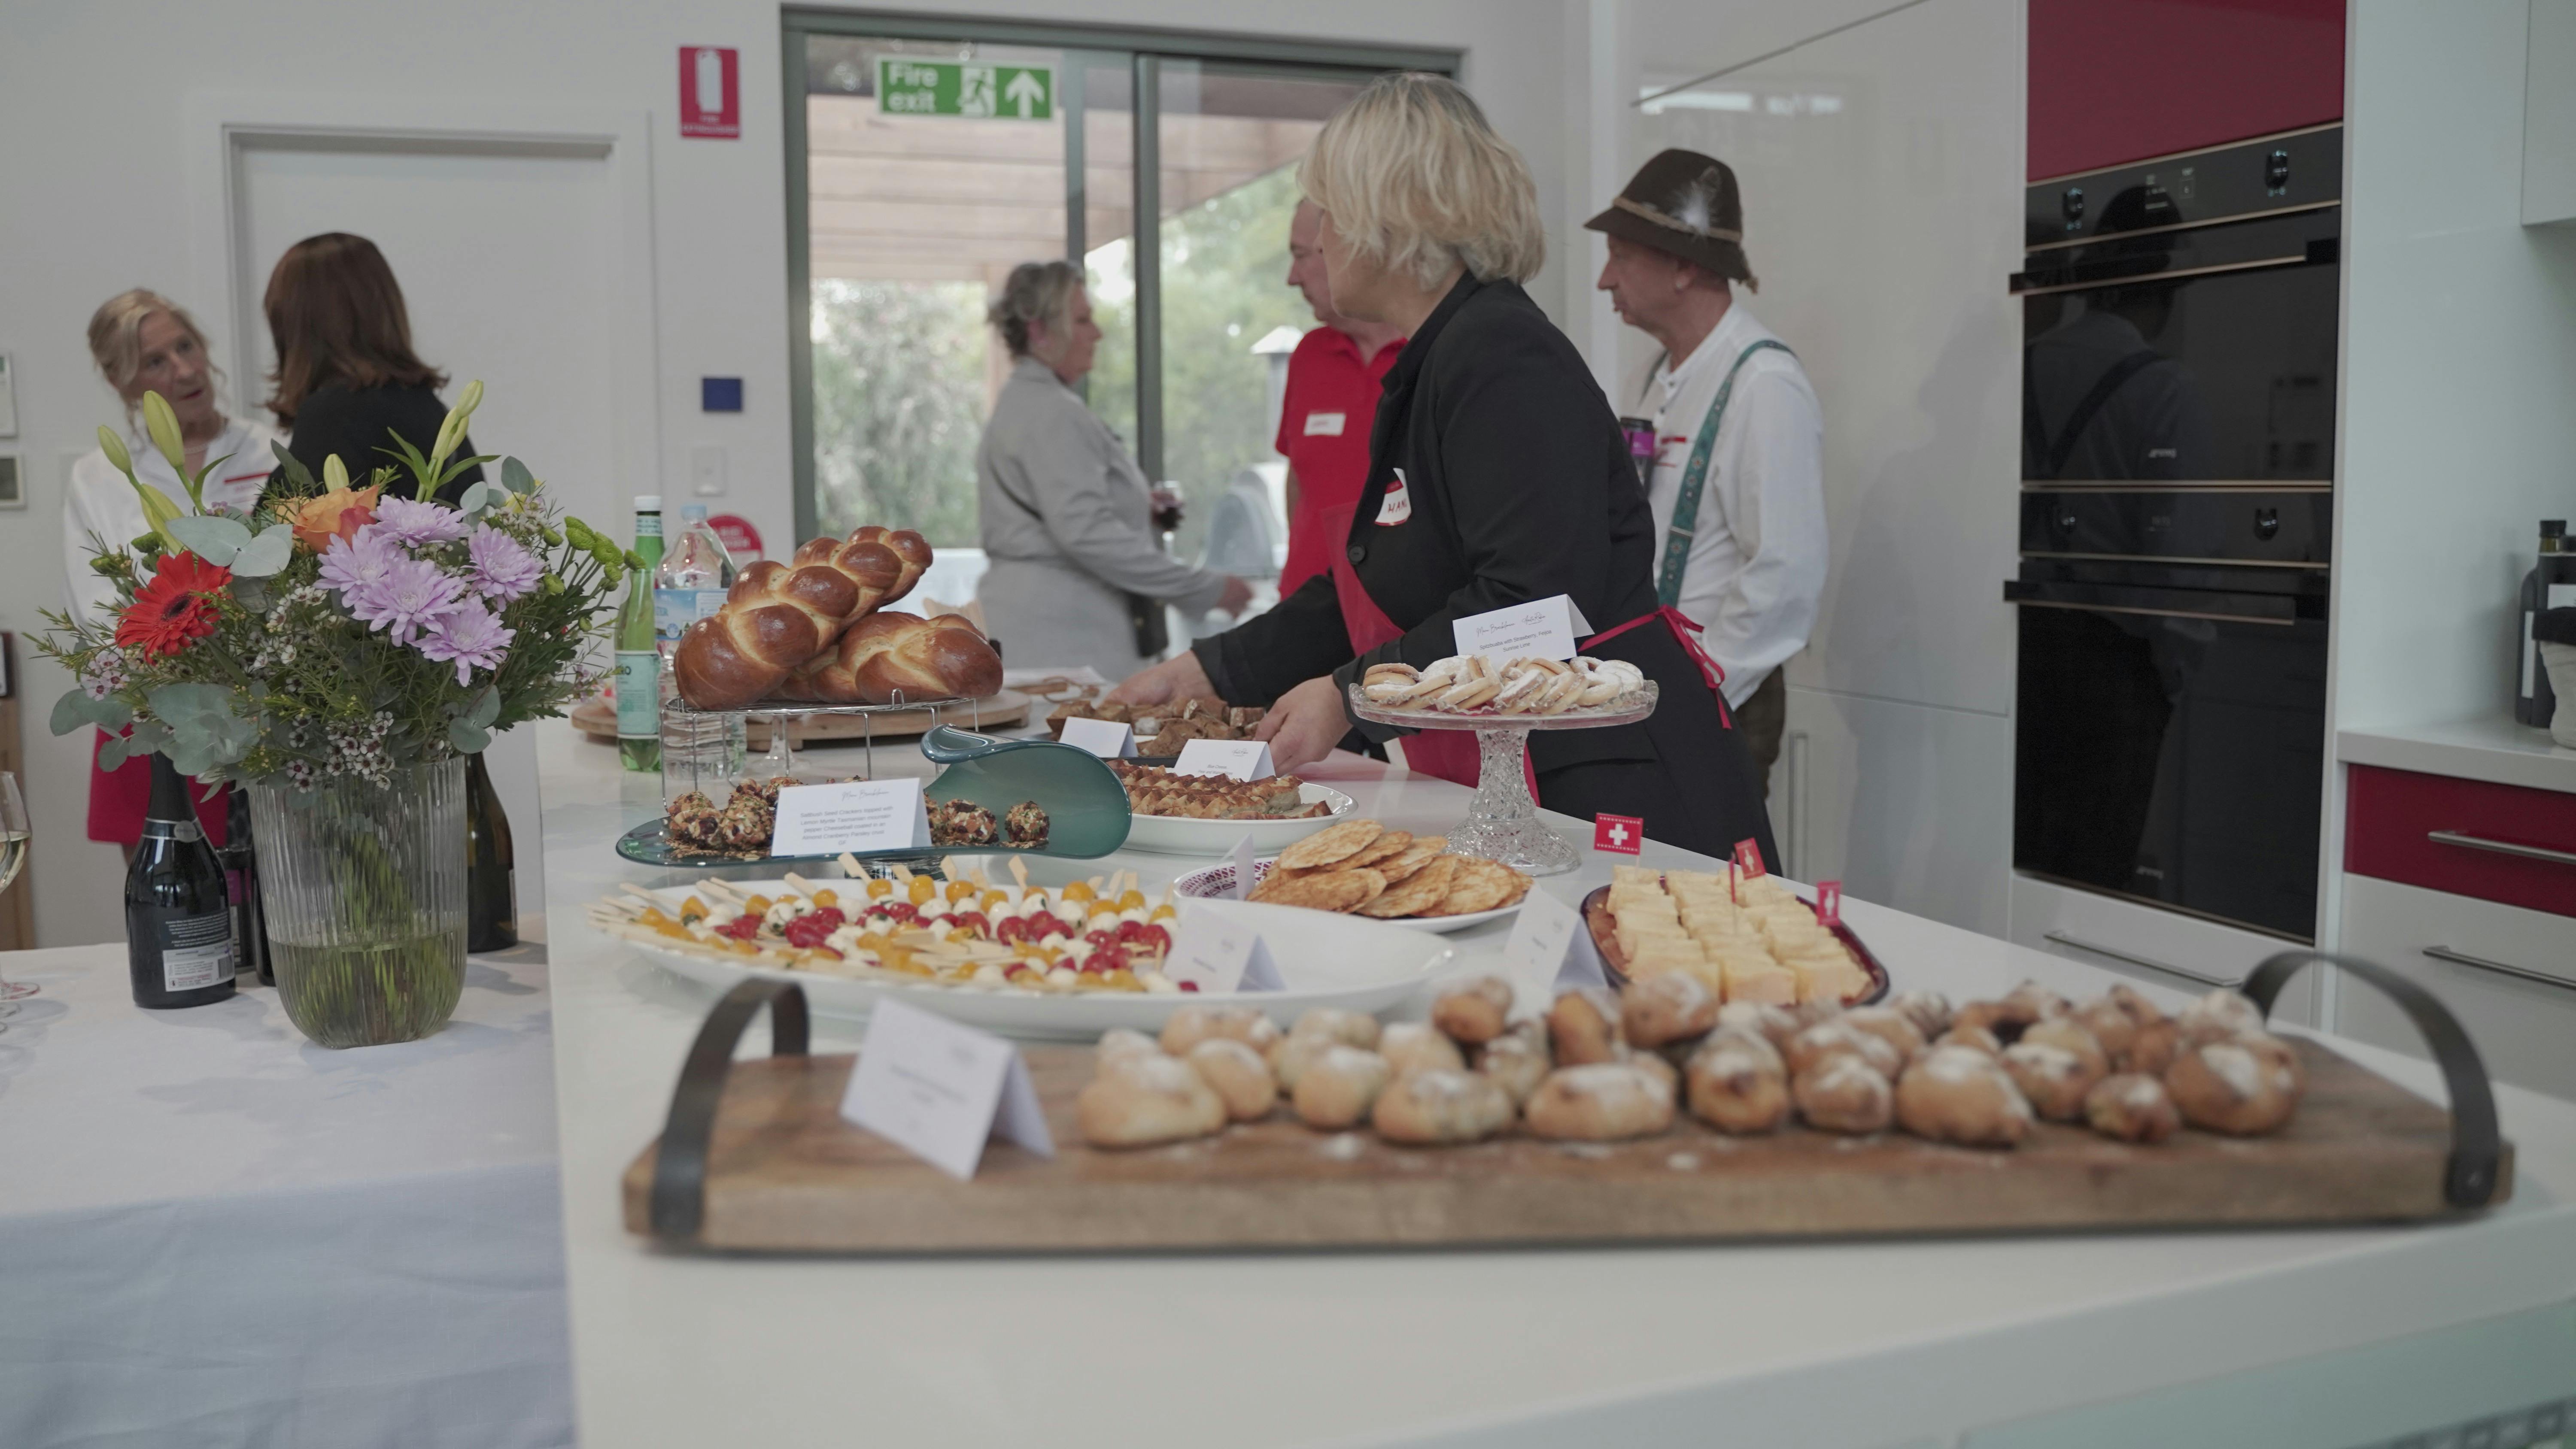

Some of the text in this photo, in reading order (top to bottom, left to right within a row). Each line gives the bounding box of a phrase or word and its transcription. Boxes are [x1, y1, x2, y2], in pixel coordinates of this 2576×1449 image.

[888, 61, 939, 88] Fire
[887, 88, 936, 113] exit
[1513, 633, 1538, 642] Strawberry,
